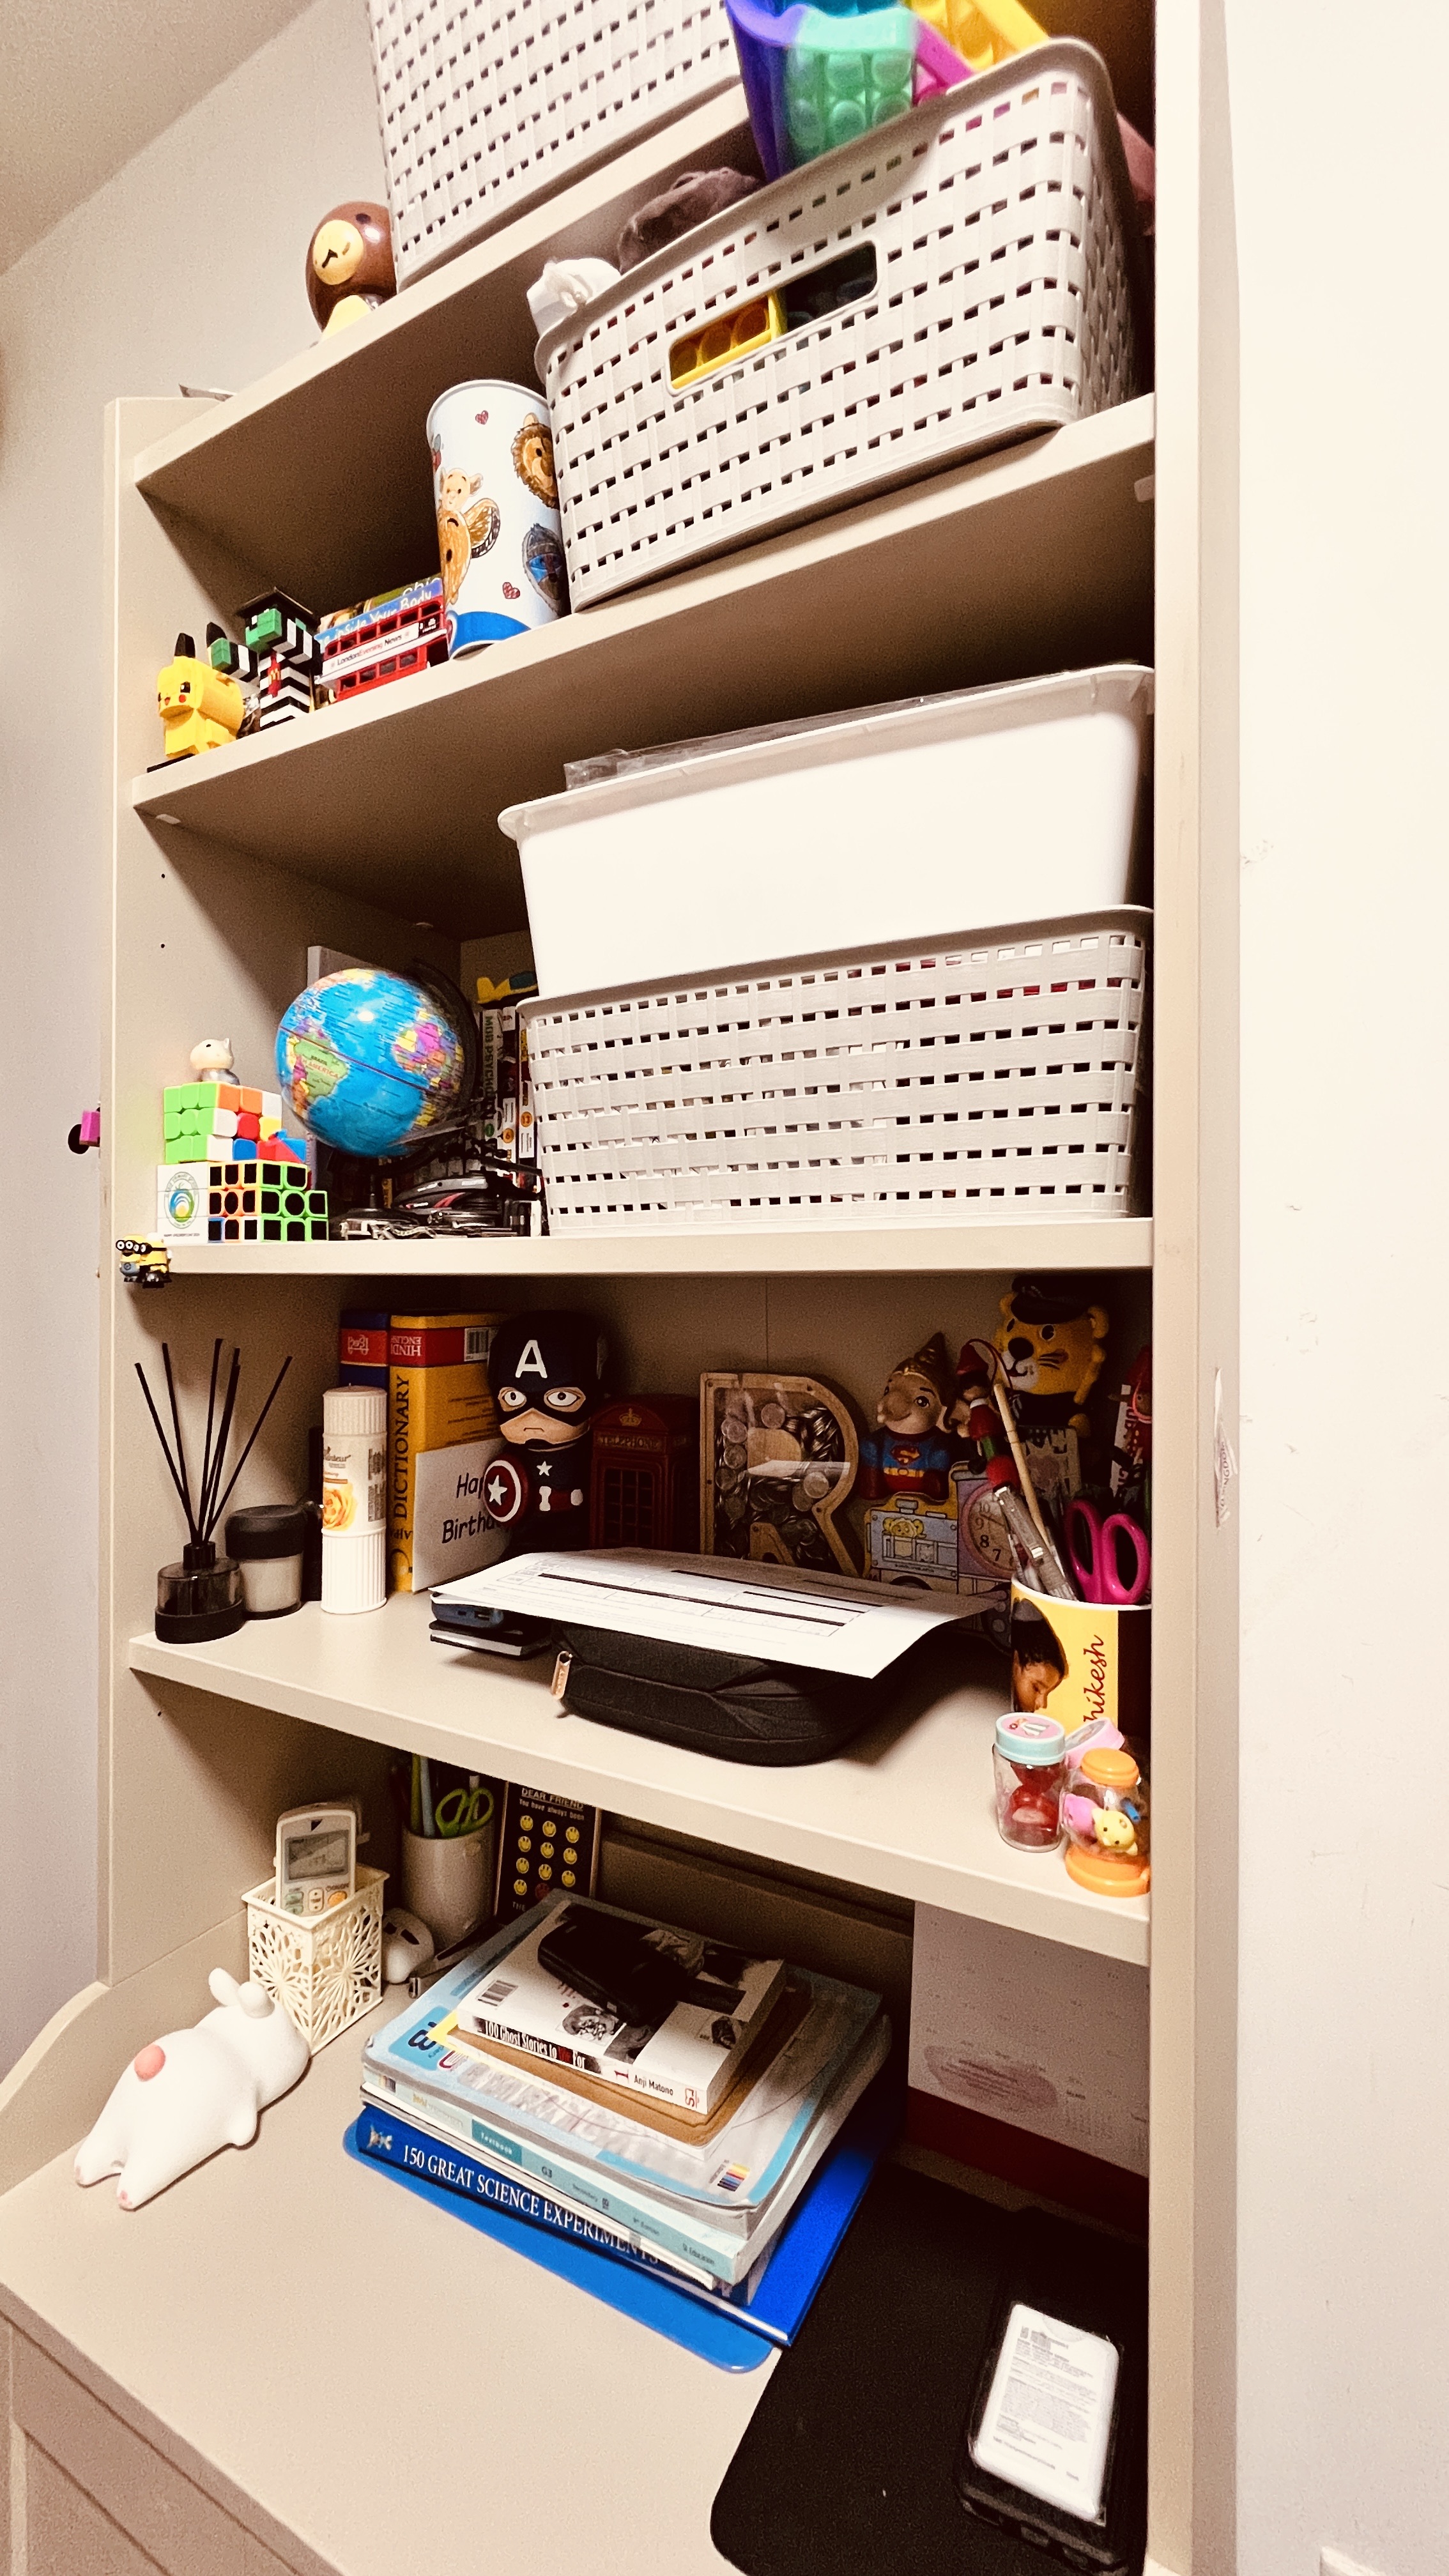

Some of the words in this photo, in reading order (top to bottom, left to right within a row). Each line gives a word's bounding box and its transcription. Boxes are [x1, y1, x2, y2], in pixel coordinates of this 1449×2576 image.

[384, 635, 402, 646] News
[485, 1016, 494, 1043] MOB
[390, 1344, 422, 1356] HINDI
[515, 1339, 548, 1378] A
[394, 1374, 410, 1519] DICTIONARY
[979, 1534, 990, 1549] 8
[993, 1548, 1002, 1562] 7
[1083, 1634, 1108, 1722] hikesh
[521, 1787, 546, 1800] DEAR
[484, 2021, 499, 2039] 100
[500, 2025, 521, 2046] Ghost
[521, 2034, 548, 2056] Stories
[573, 2050, 586, 2070] For
[634, 2074, 647, 2089] Anji
[648, 2079, 673, 2096] Matono
[403, 2145, 425, 2168] 150
[427, 2154, 475, 2188] GREAT
[477, 2174, 540, 2217] SCIENCE
